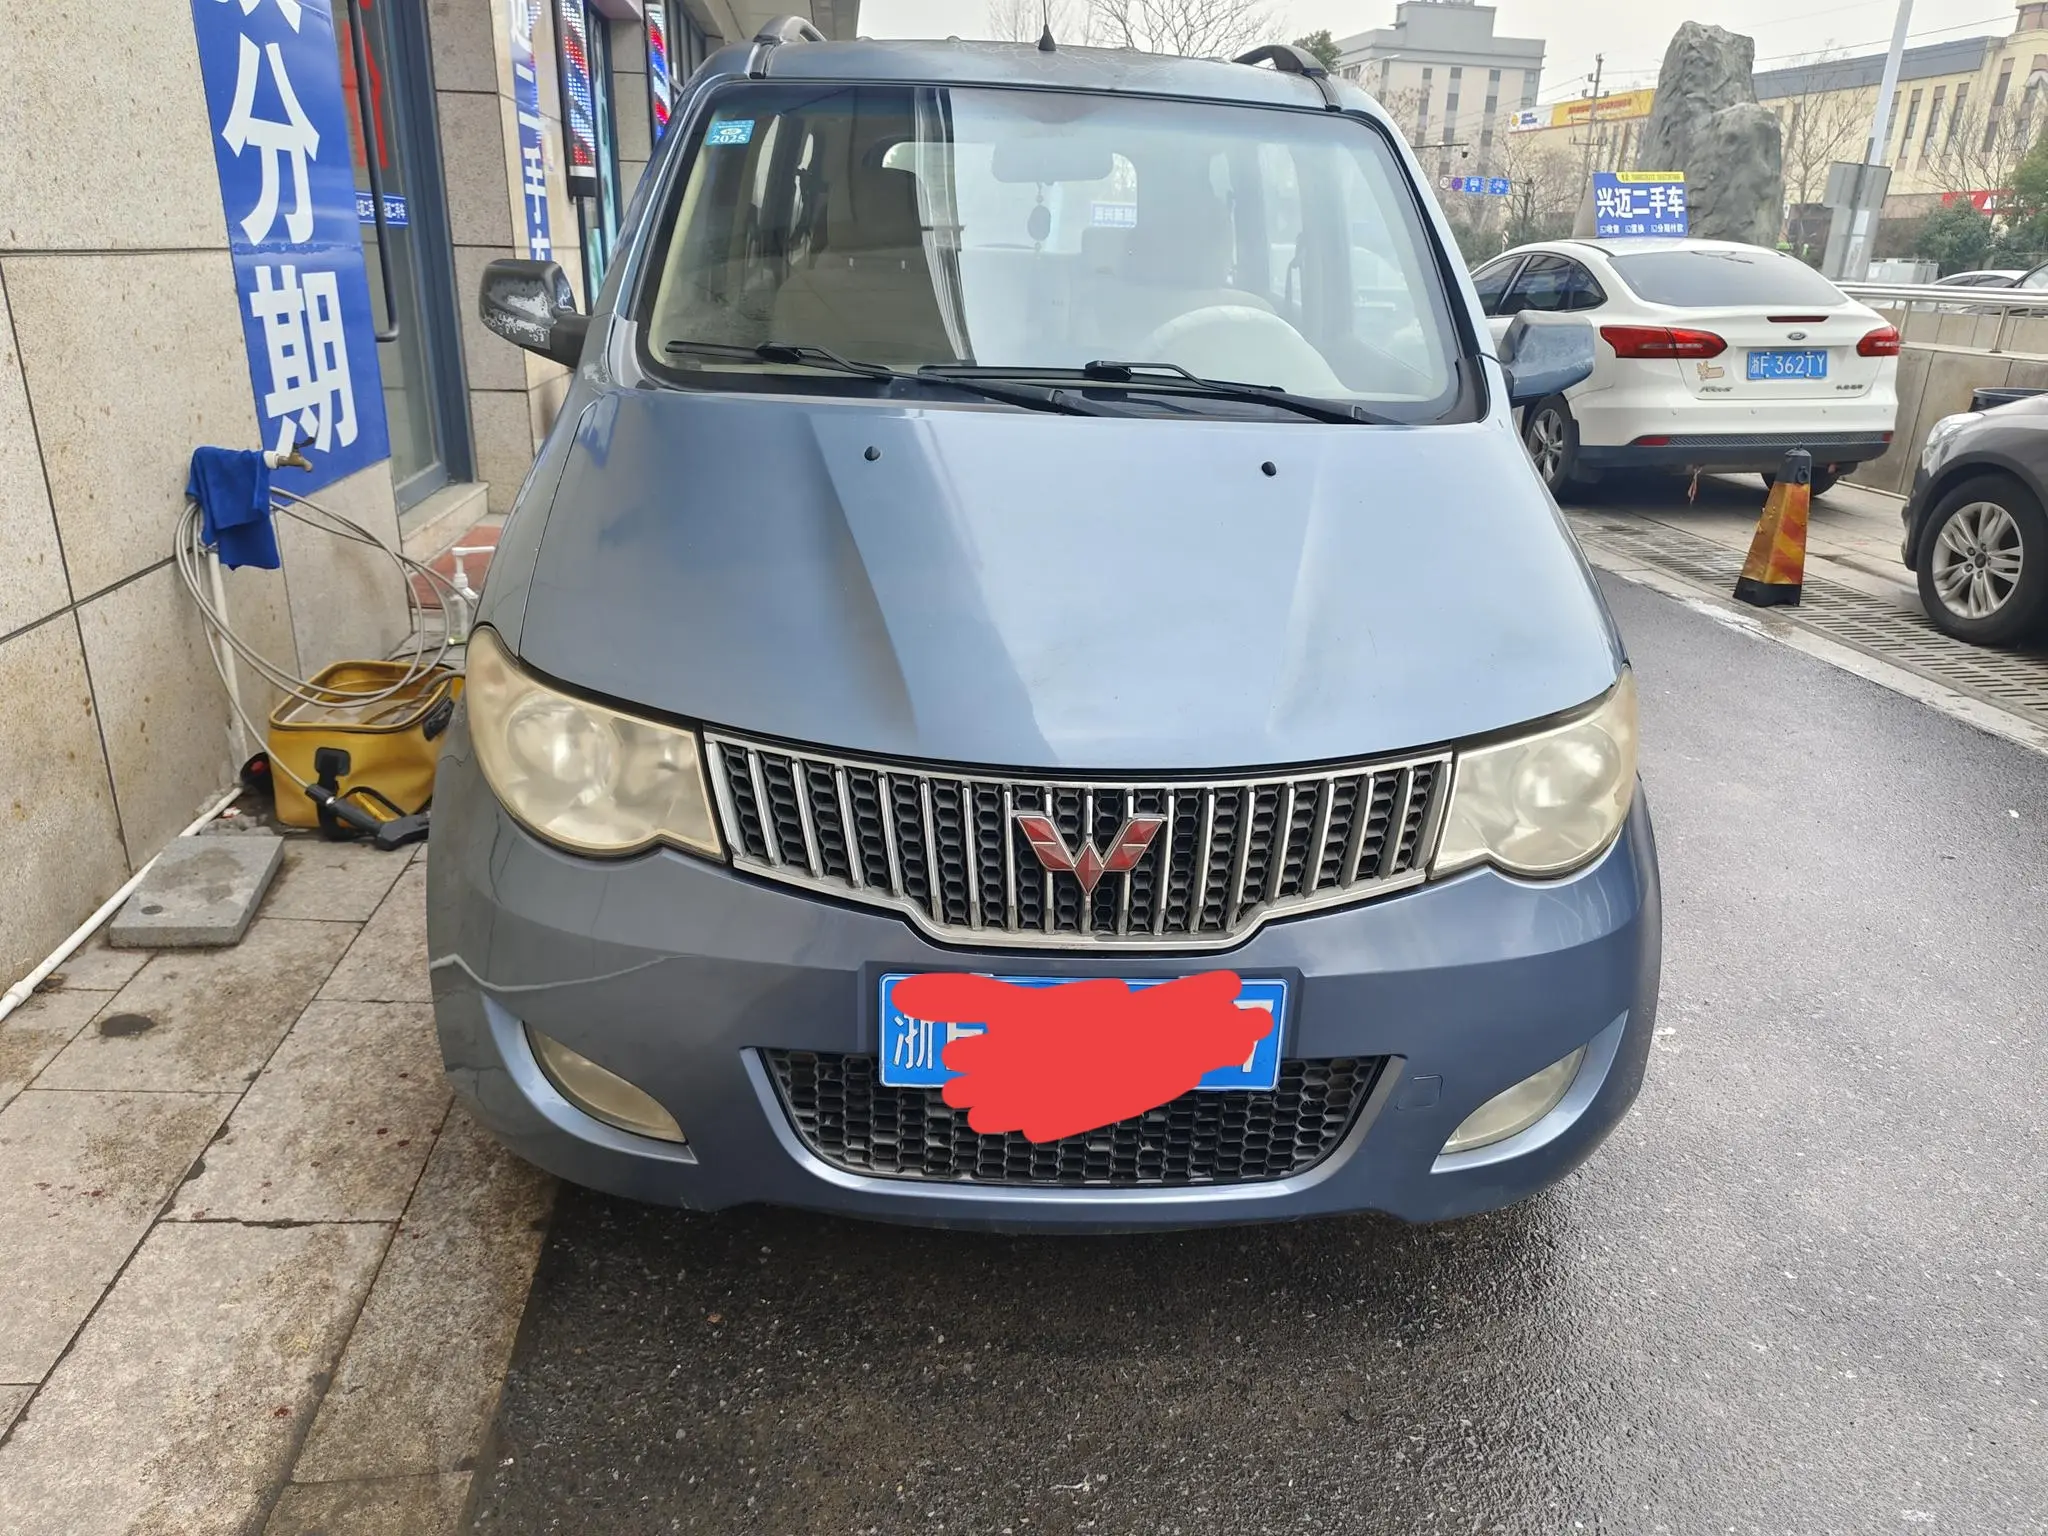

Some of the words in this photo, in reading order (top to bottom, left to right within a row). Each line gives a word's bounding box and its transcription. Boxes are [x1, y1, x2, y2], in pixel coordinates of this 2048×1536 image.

[712, 134, 747, 144] 2025
[1597, 186, 1685, 219] 兴迈二手车
[214, 0, 357, 455] 分期
